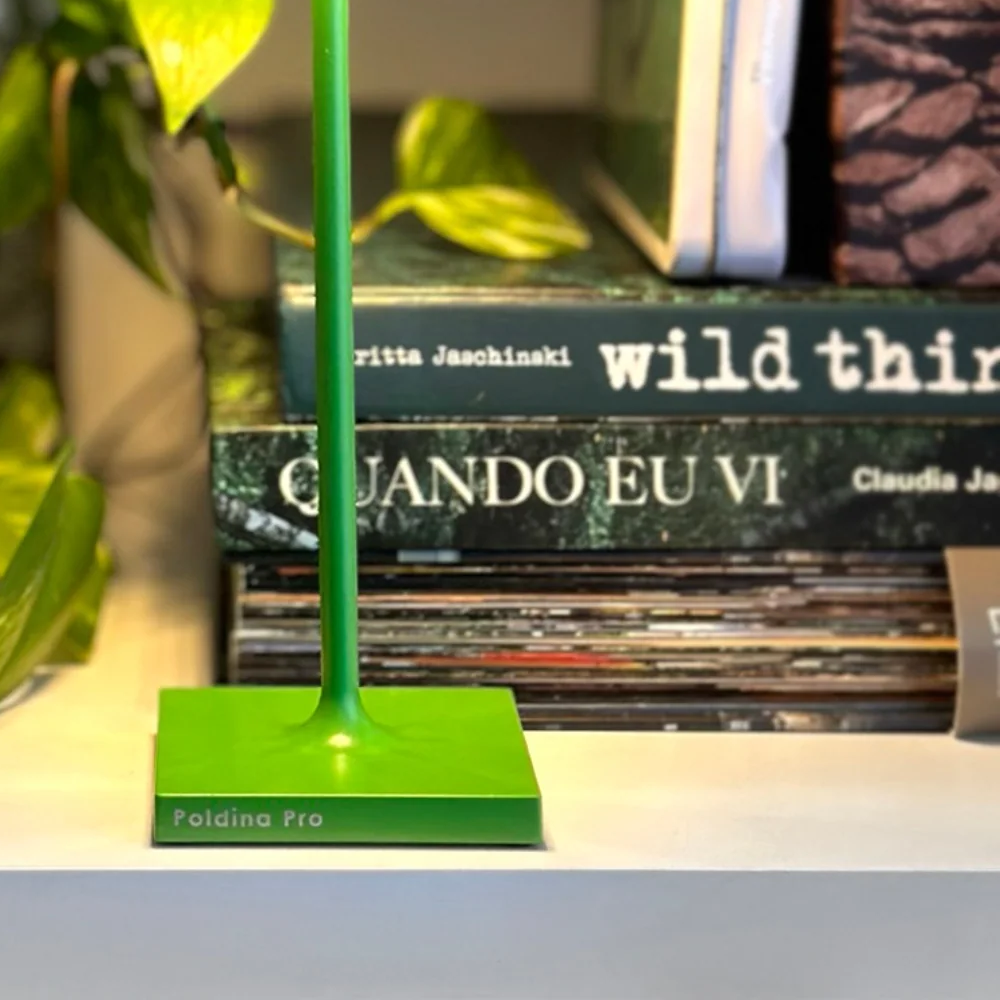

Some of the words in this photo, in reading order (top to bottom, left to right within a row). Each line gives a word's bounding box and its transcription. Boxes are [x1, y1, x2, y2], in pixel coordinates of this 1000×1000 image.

[354, 345, 424, 366] ritta
[432, 344, 572, 367] Jaschinski
[599, 326, 800, 391] wild
[604, 455, 697, 505] EU
[714, 455, 783, 506] VI
[852, 466, 957, 492] Claudia
[173, 807, 272, 828] Poldina
[283, 809, 324, 828] Pro
